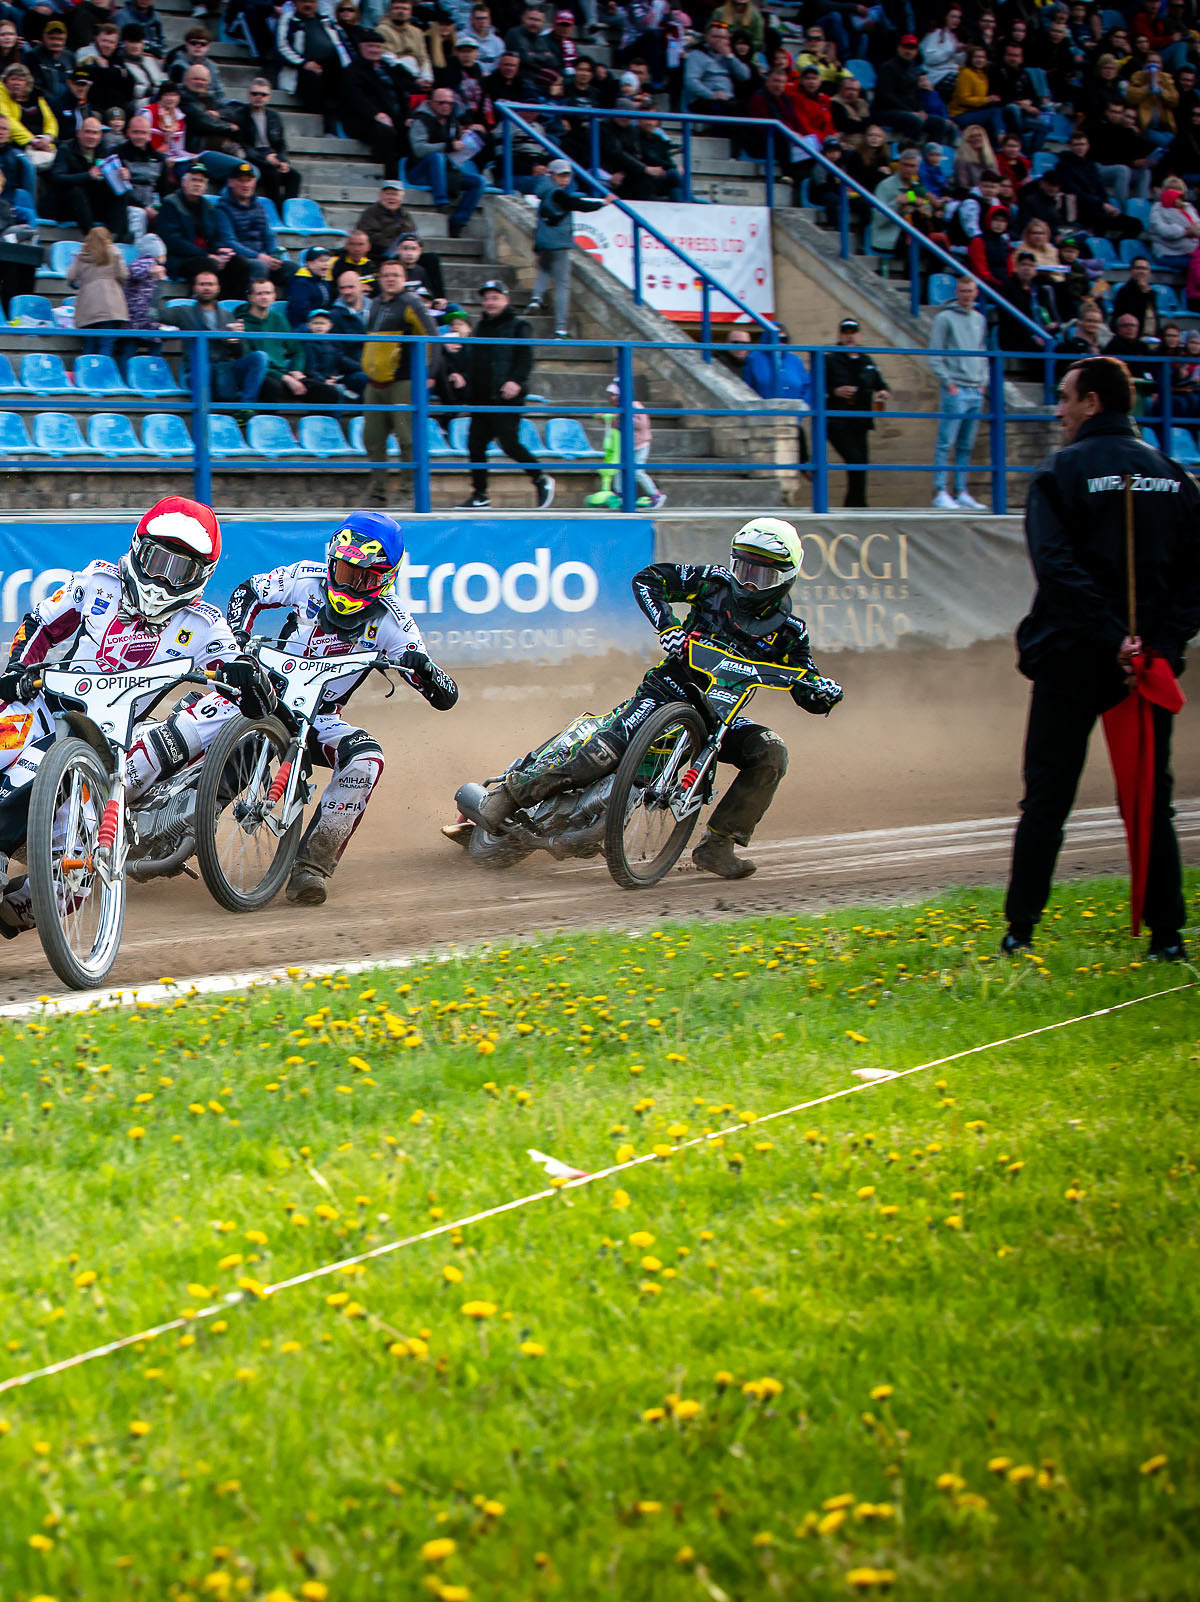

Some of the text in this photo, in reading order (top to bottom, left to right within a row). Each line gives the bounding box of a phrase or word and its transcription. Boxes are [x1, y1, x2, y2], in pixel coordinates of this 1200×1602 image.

[798, 534, 909, 580] OGGI
[518, 627, 599, 650] ONLINE
[299, 660, 345, 674] OPTIBET
[96, 676, 152, 690] OPTIBET
